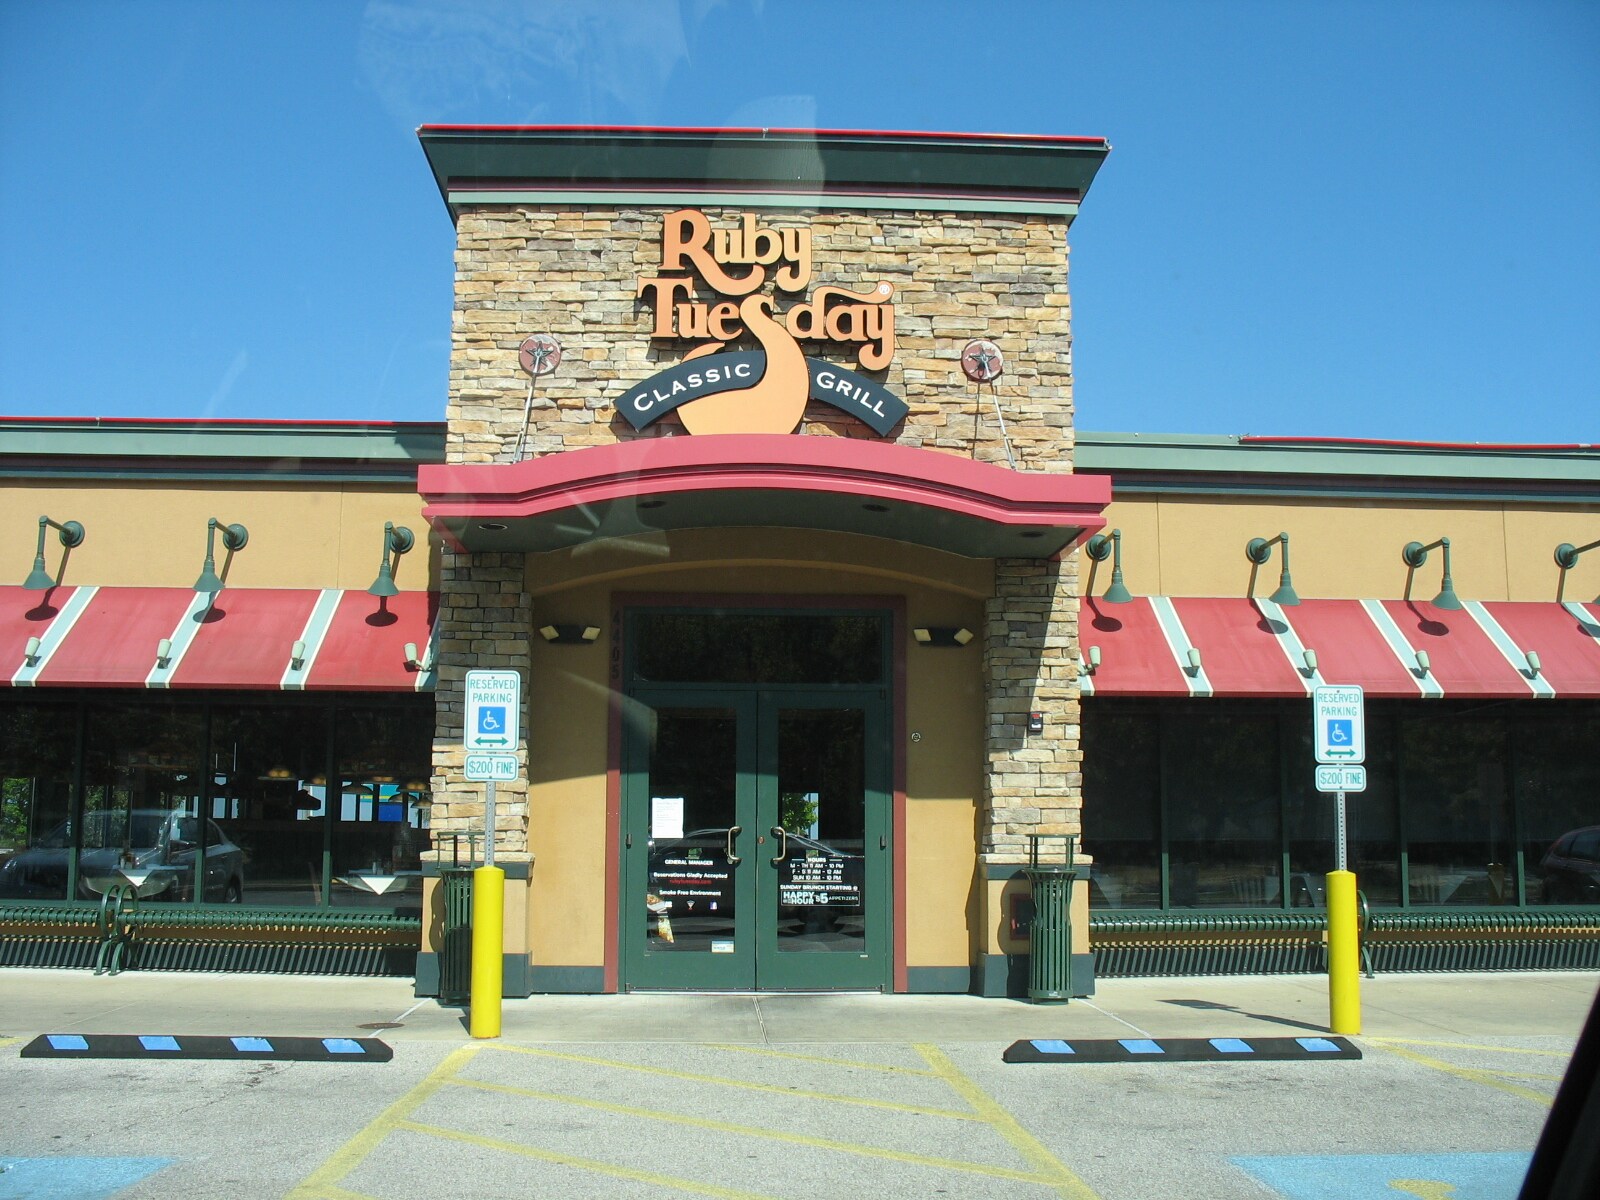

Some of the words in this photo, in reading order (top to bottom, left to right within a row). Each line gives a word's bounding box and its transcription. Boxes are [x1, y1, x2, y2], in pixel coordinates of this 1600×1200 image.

[658, 208, 812, 296] Ruby
[636, 275, 896, 434] Tuesday
[633, 363, 752, 412] CLASSIC
[816, 371, 885, 418] GRILL
[470, 679, 516, 690] RESERVED
[472, 693, 512, 703] PARKING
[1317, 693, 1360, 703] RESERVED
[1321, 706, 1357, 717] PARKING
[469, 760, 493, 774] $200
[496, 761, 514, 774] FINE
[1320, 772, 1343, 785] $200
[1345, 772, 1362, 785] FINE
[783, 891, 815, 899] HAPPY
